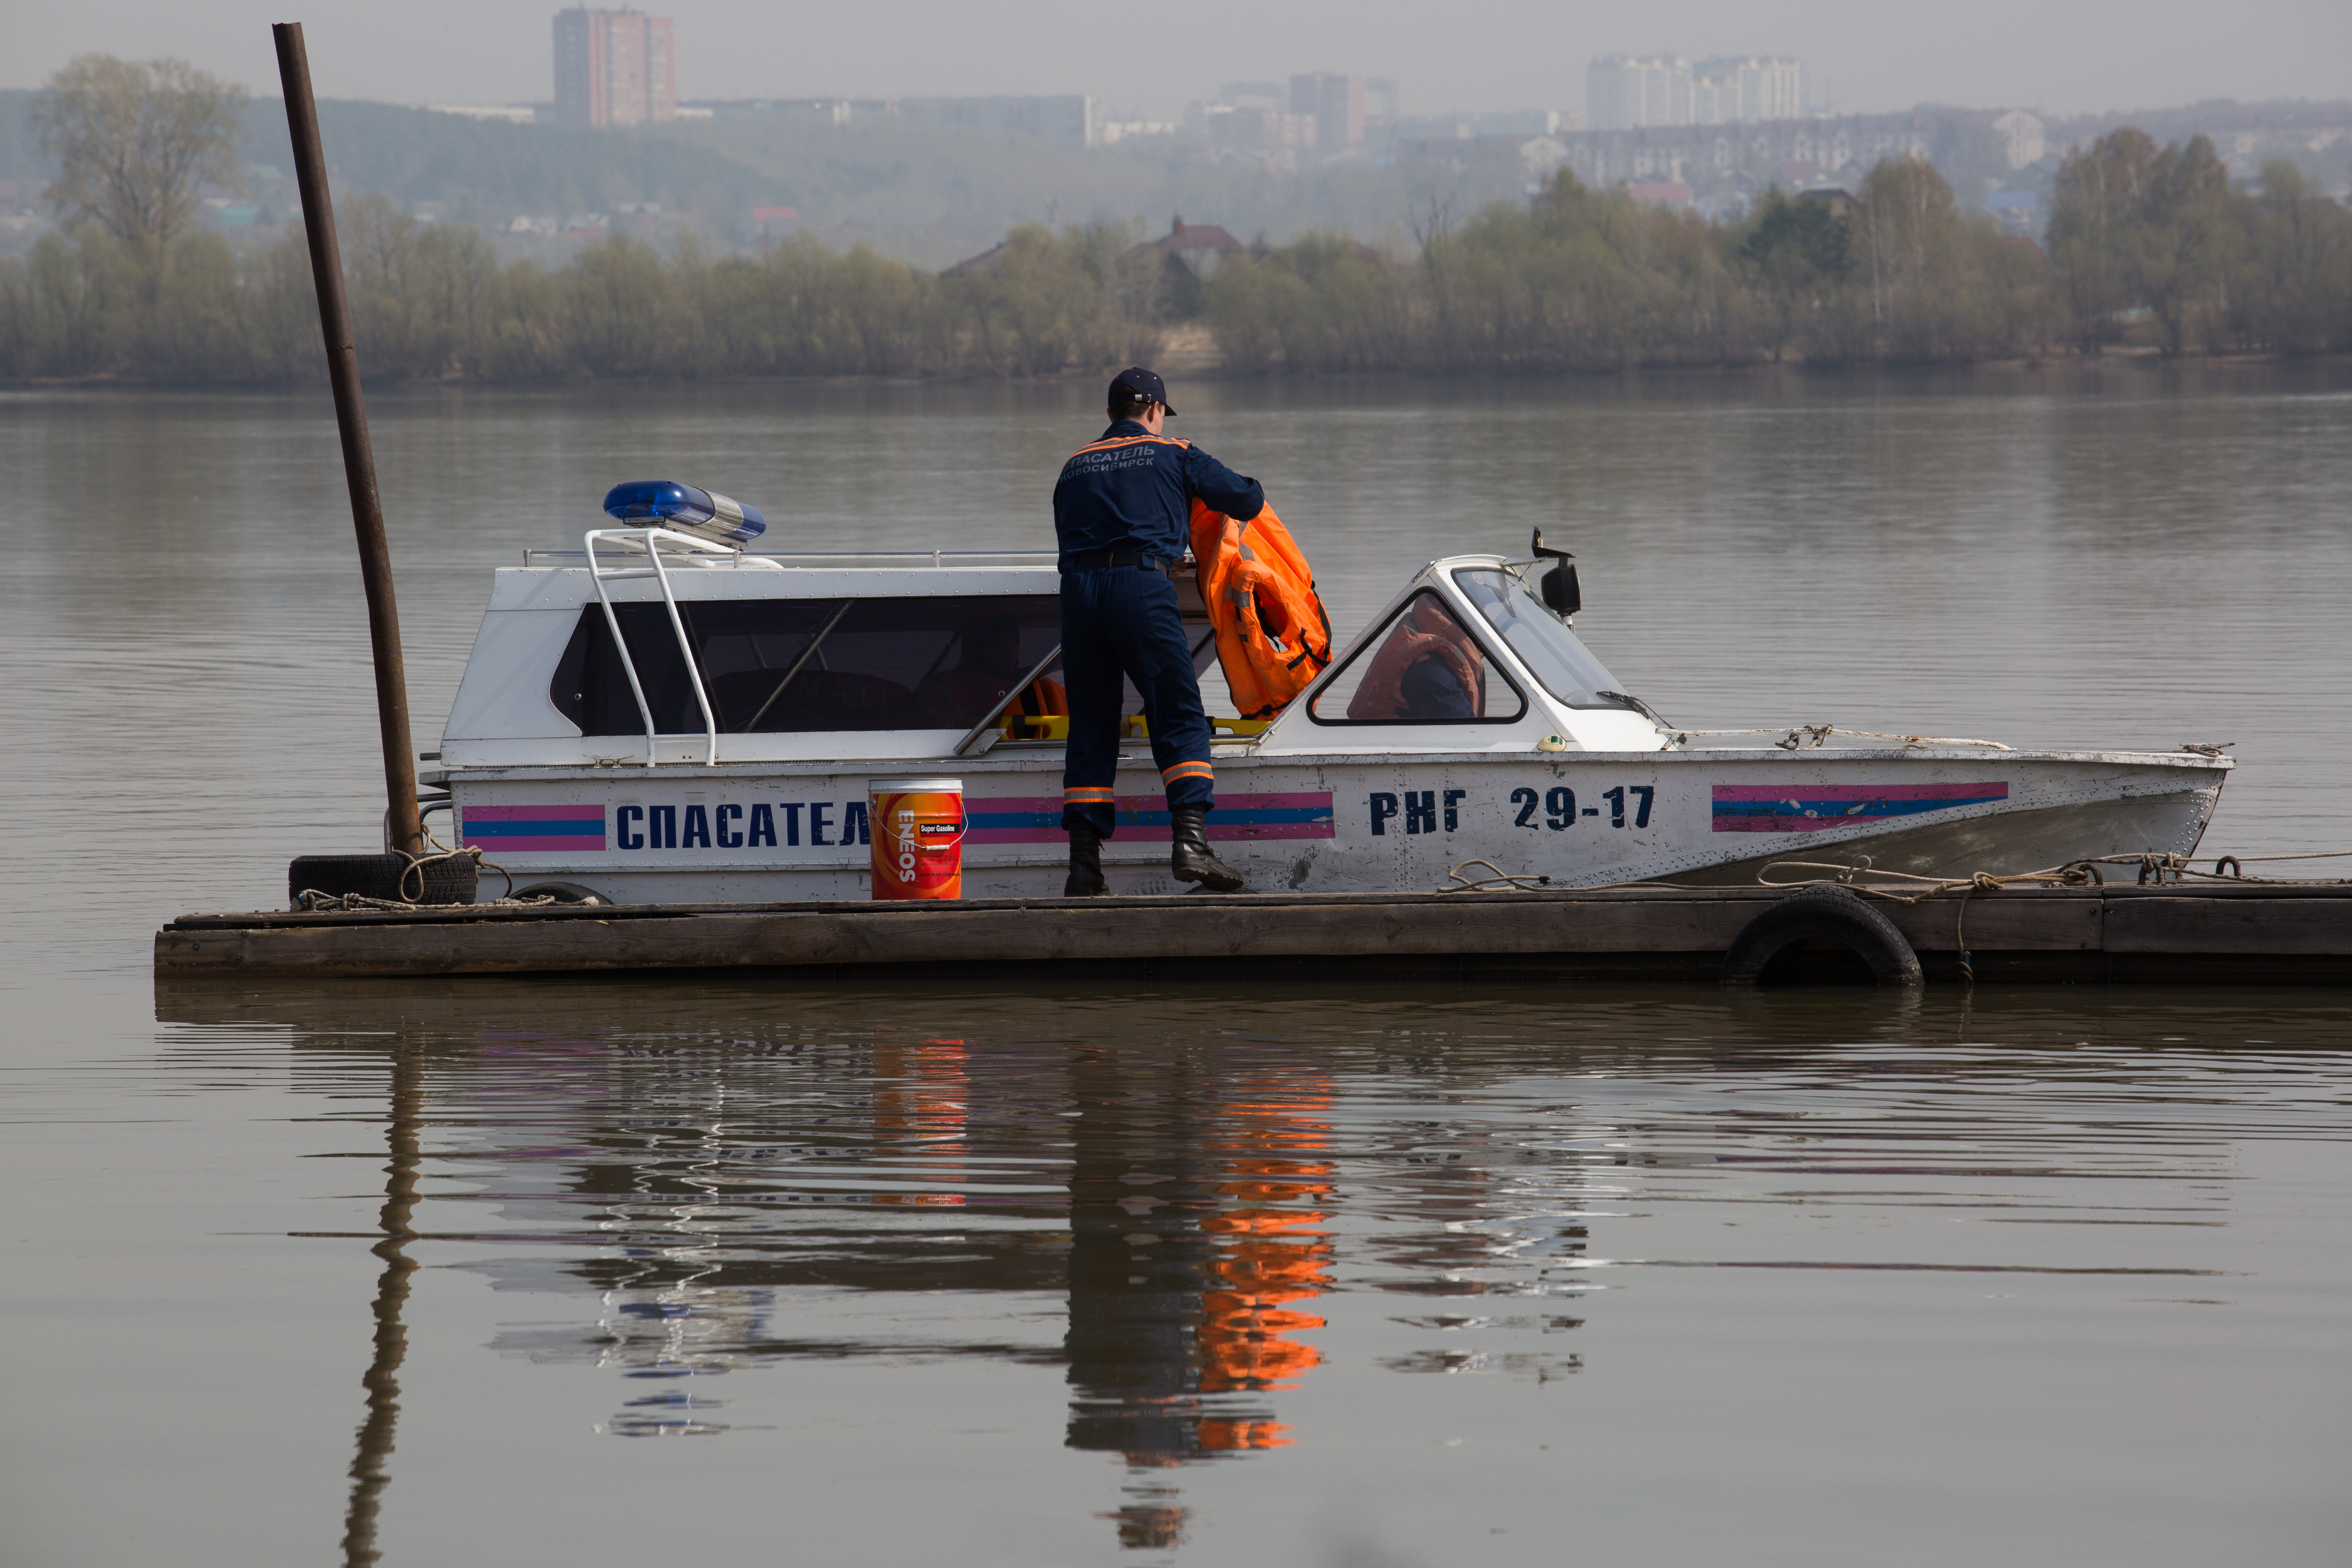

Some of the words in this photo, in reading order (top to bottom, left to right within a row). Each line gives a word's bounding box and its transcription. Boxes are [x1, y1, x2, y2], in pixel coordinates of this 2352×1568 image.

[1060, 458, 1154, 483] НОВОСИБИРСК
[1064, 446, 1154, 472] СПАСАТЕЛЬ
[1370, 790, 1466, 835] РНГ
[1511, 786, 1654, 831] 29-17
[921, 825, 935, 833] Super
[898, 810, 915, 882] ENEOS
